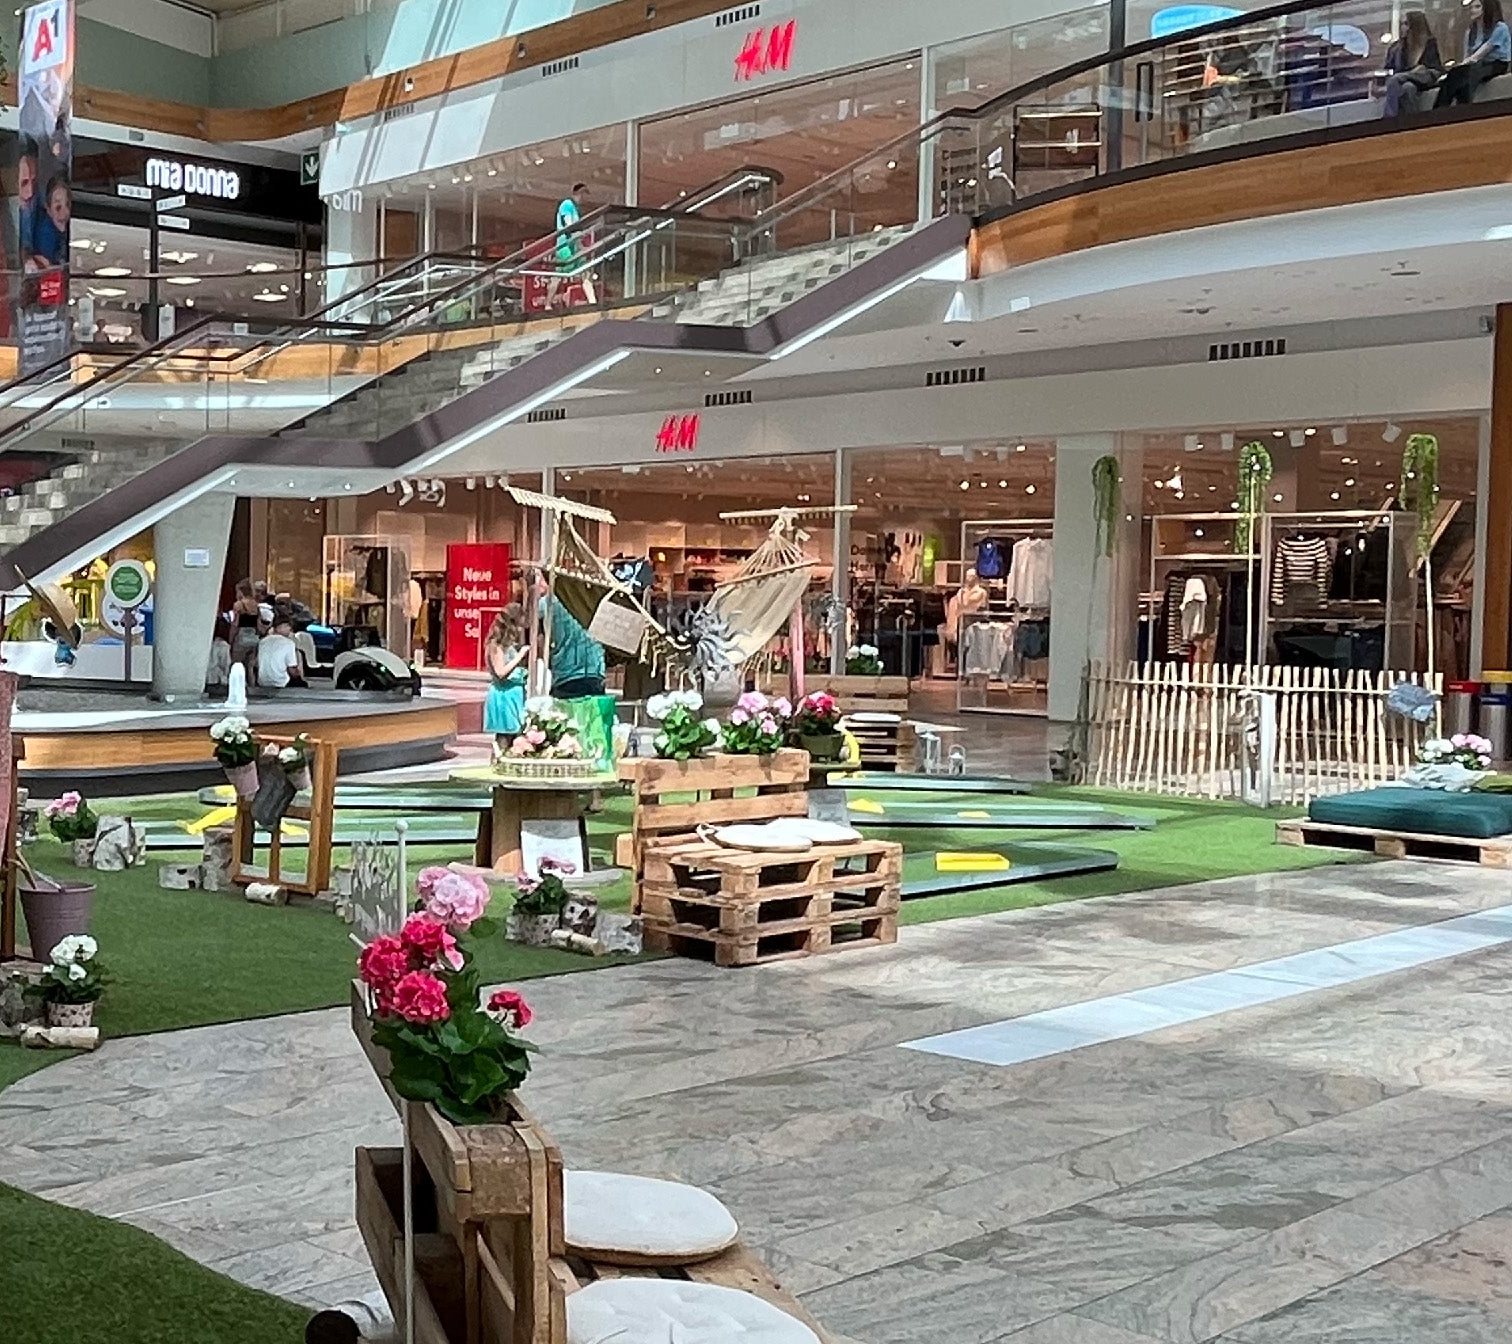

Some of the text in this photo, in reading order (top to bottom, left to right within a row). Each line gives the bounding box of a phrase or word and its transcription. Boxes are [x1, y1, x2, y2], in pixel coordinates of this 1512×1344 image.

[31, 8, 60, 63] A1
[734, 19, 797, 82] H&M
[655, 413, 699, 453] H&M
[454, 585, 487, 604] Styles
[462, 567, 493, 583] Neue
